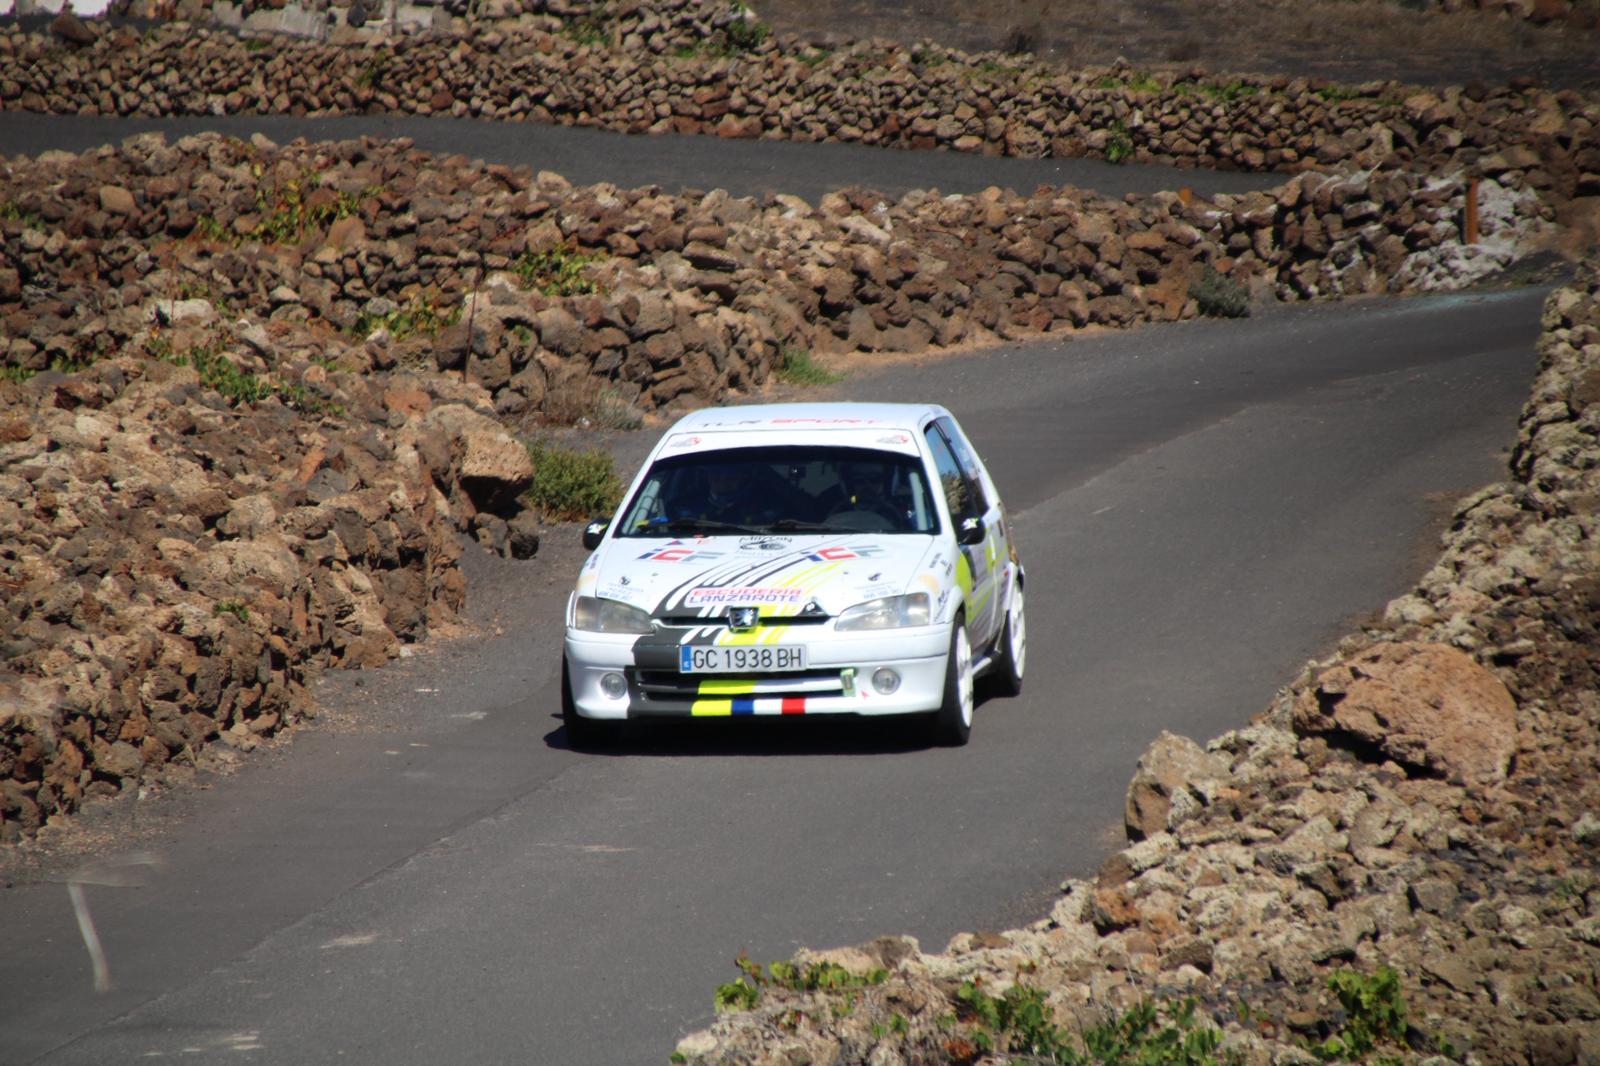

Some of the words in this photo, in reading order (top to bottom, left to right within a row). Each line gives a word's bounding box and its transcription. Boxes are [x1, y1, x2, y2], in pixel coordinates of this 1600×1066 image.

[689, 594, 801, 603] LANZAROTE
[693, 649, 718, 669] GC
[725, 648, 773, 668] 1938
[777, 648, 801, 668] BH
